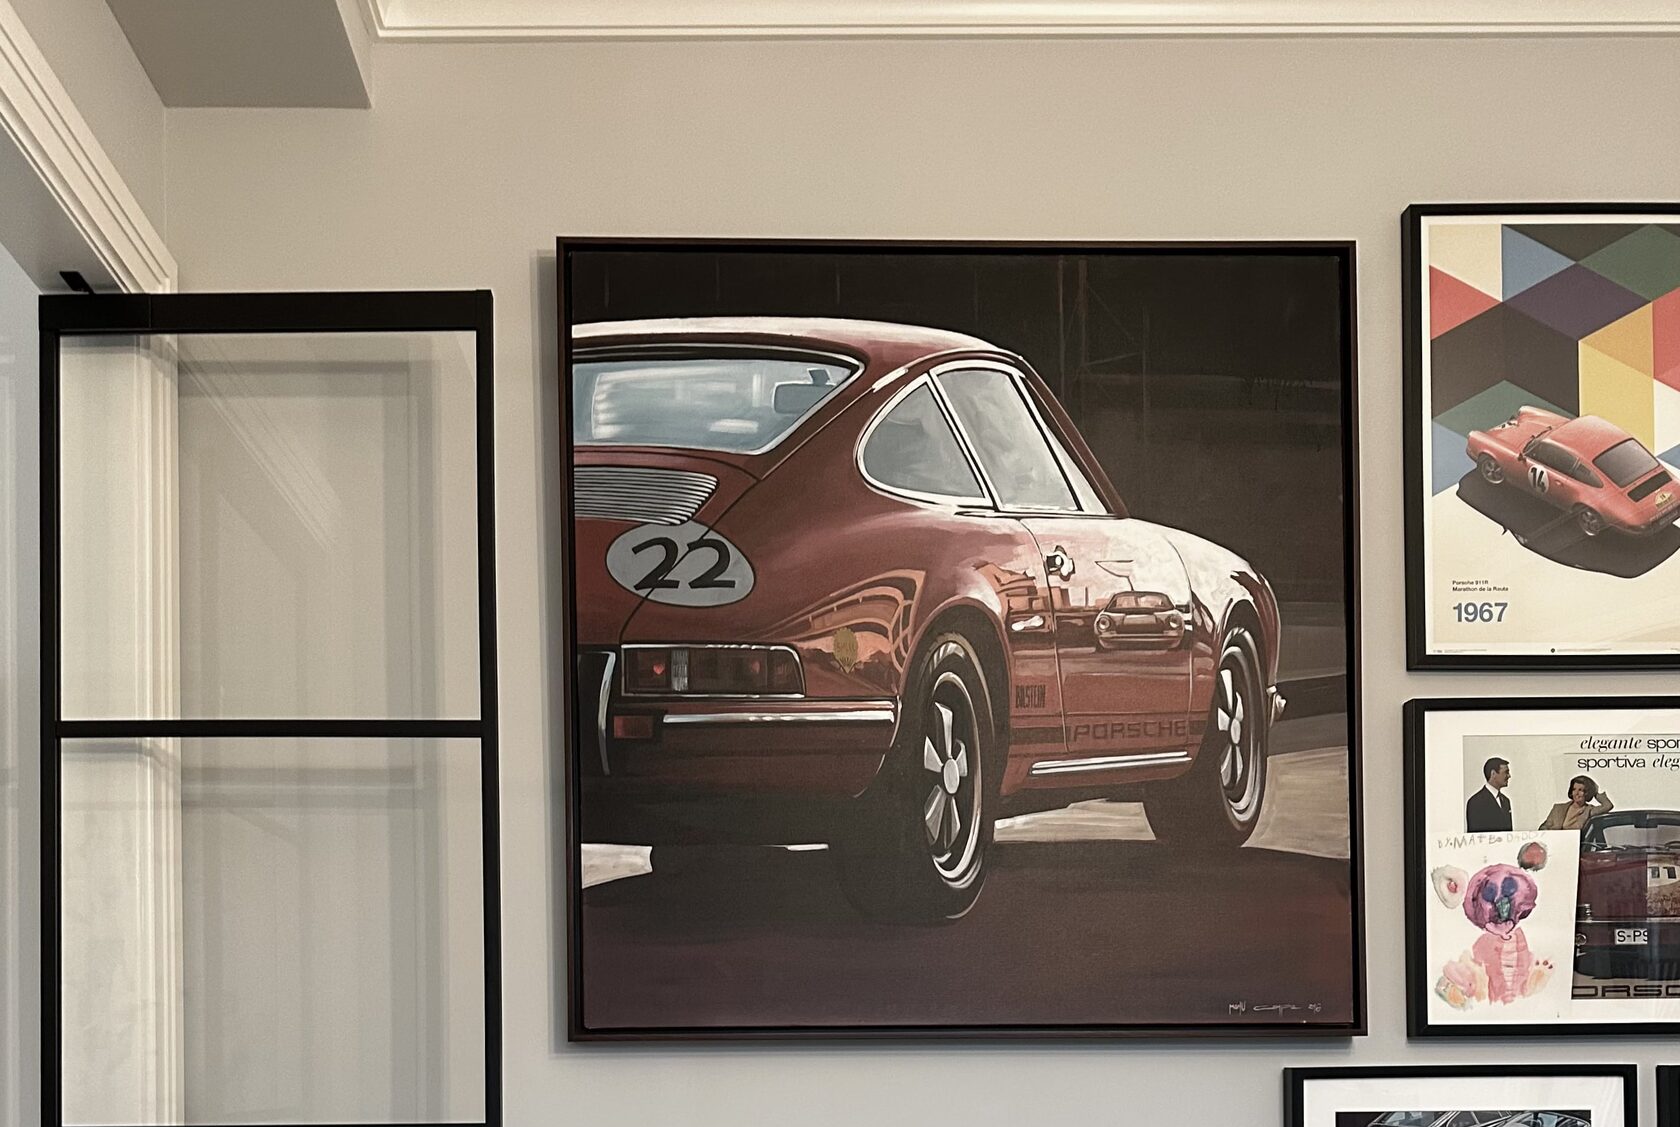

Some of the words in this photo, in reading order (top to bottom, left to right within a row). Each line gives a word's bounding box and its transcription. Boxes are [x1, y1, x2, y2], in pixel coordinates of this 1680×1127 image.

[1530, 467, 1546, 492] 14
[632, 537, 736, 591] 22
[1453, 602, 1508, 622] 1967
[1074, 720, 1188, 742] PORSCHE
[1580, 736, 1642, 752] elegante
[1577, 755, 1646, 772] sportiva
